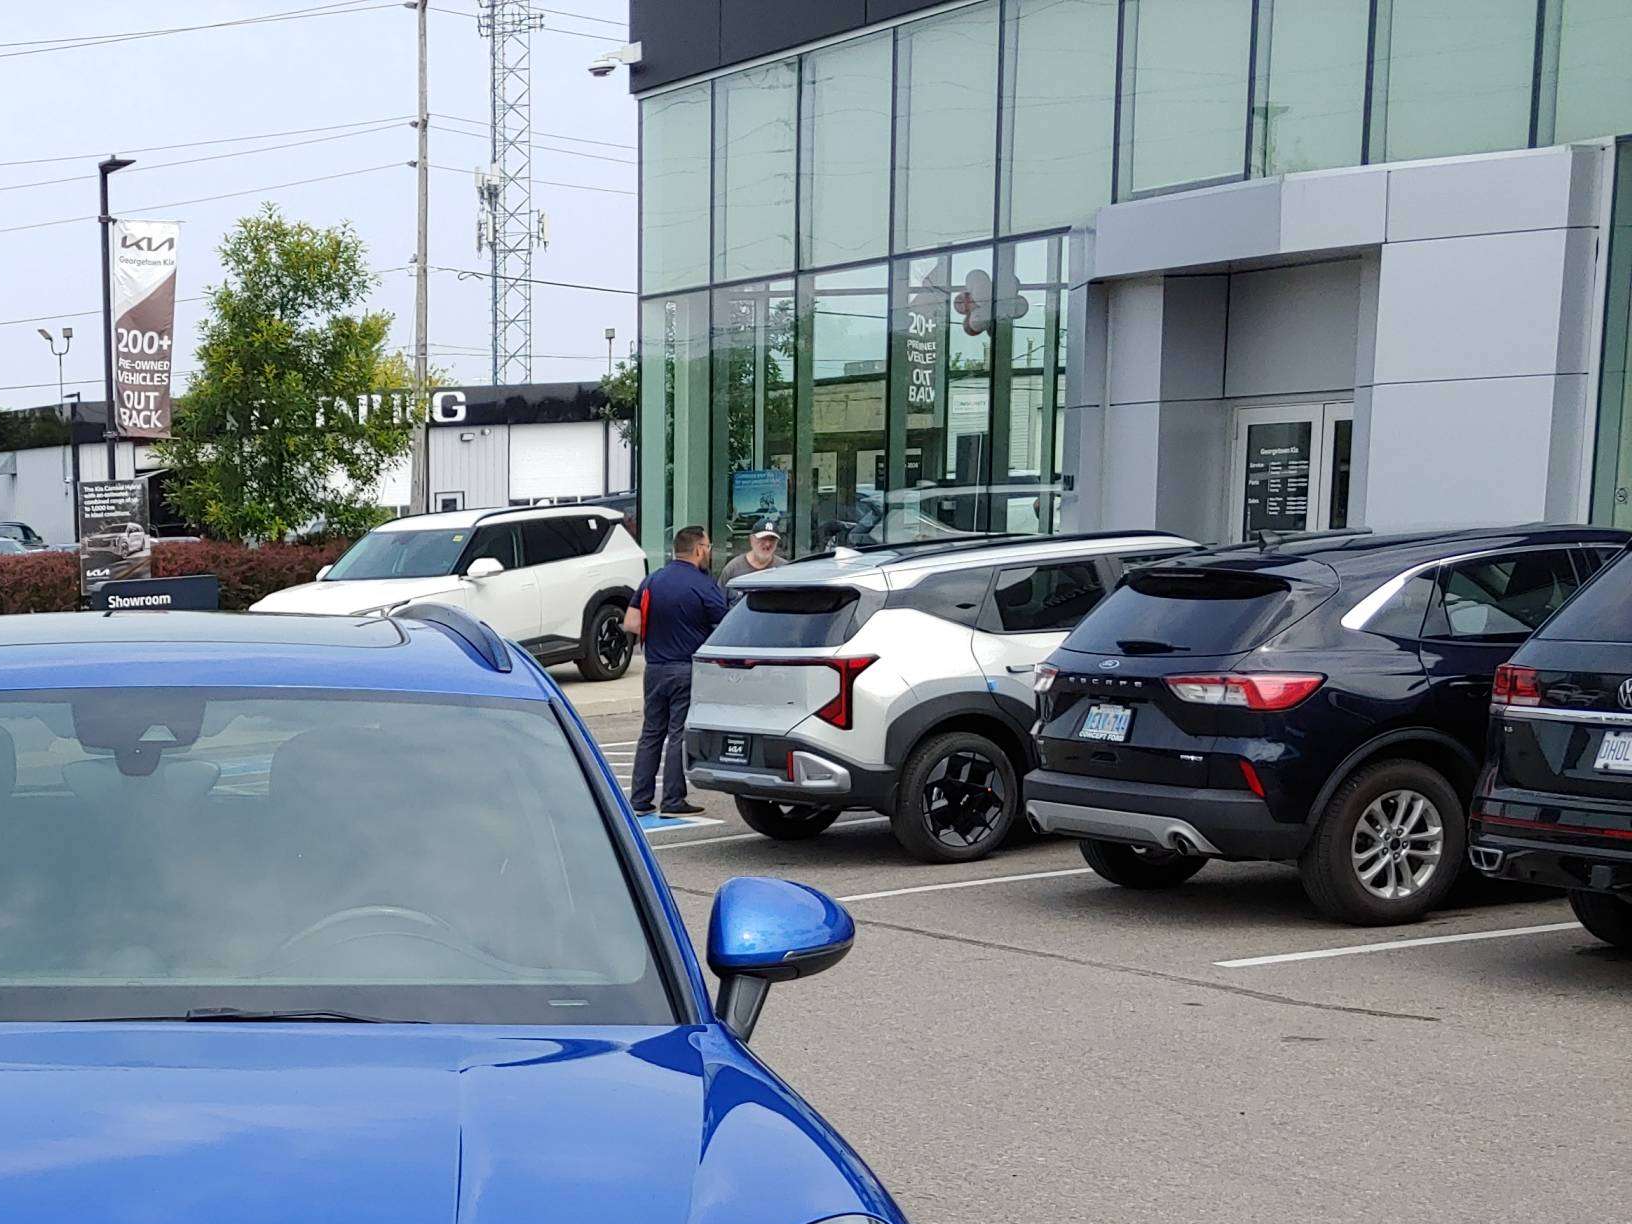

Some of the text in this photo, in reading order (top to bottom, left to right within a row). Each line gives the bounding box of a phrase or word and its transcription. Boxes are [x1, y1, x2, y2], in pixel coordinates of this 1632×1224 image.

[121, 236, 174, 252] KIA
[119, 256, 161, 266] Georgetown
[117, 328, 171, 355] 200+
[118, 357, 170, 371] PRE-OWNED
[118, 370, 169, 386] VEHICLES
[123, 391, 159, 410] OUT
[120, 407, 163, 429] BACK
[108, 595, 171, 609] Showroom
